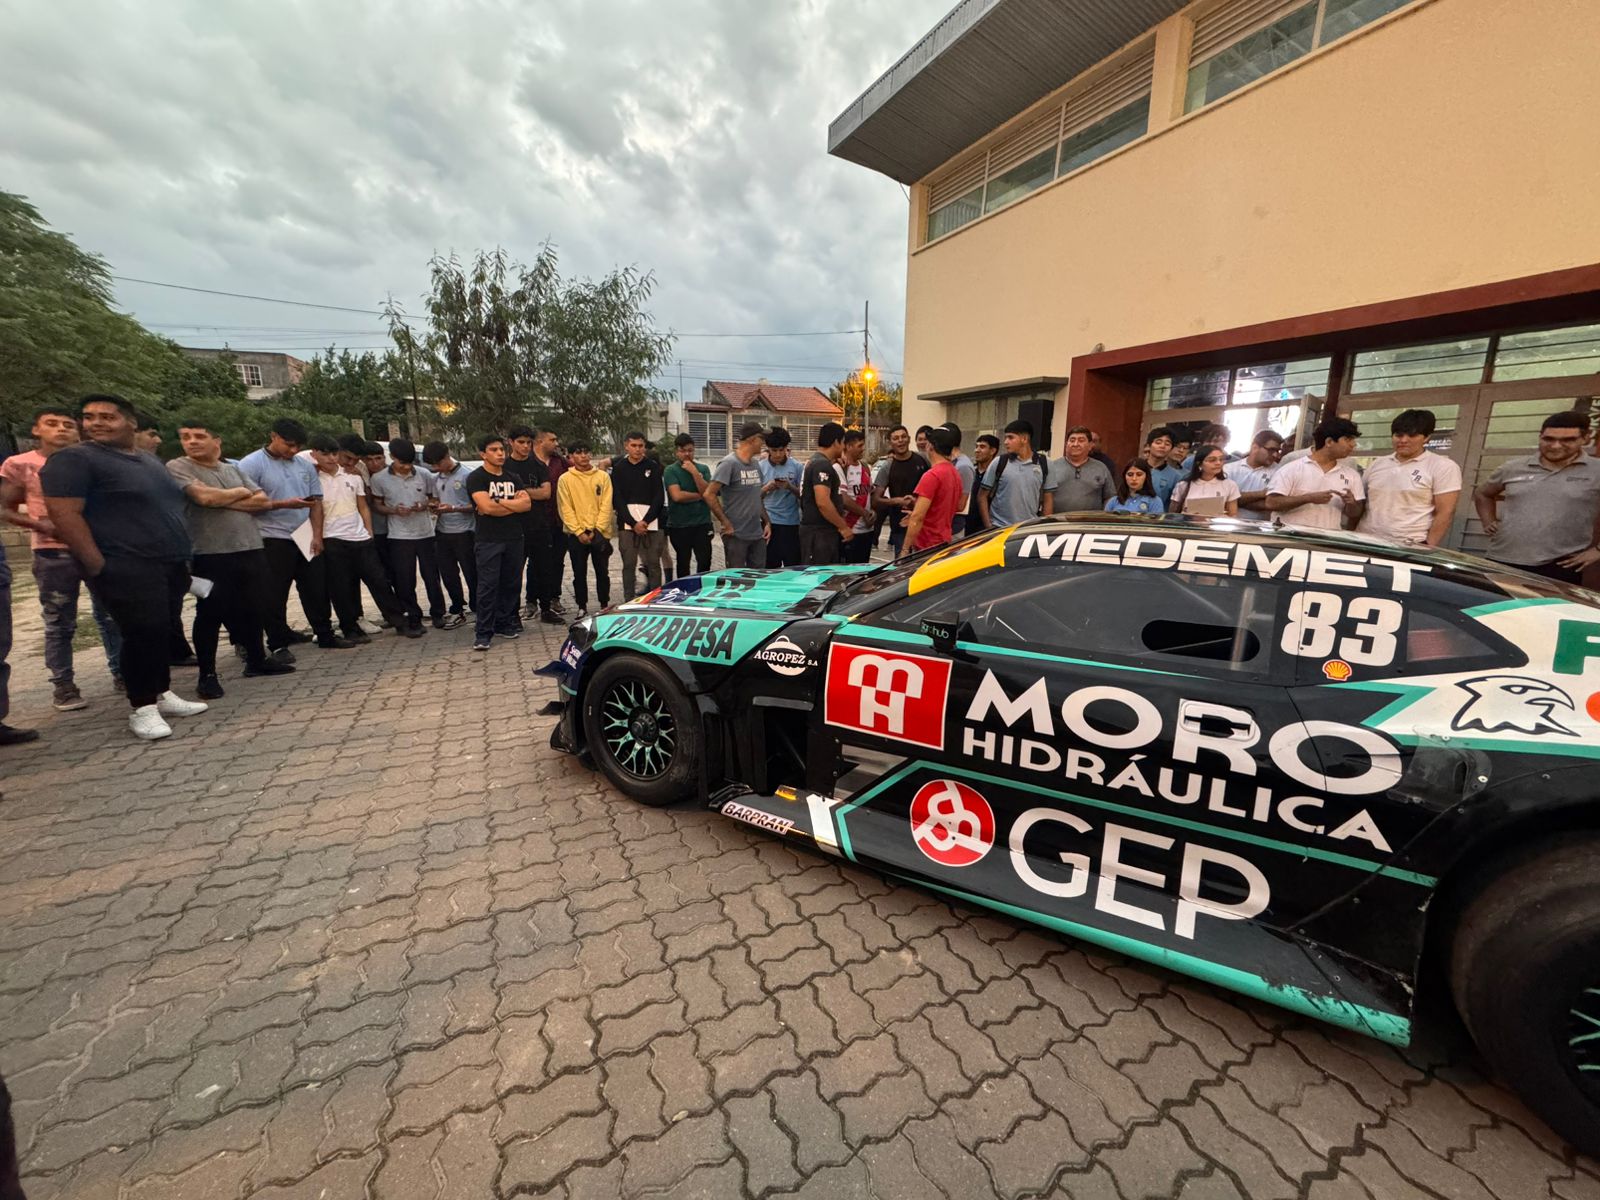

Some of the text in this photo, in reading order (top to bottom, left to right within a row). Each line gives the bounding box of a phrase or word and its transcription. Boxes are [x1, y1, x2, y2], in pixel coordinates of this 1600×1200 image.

[489, 481, 515, 499] ACID
[1018, 533, 1433, 593] MEDEMET
[600, 615, 738, 660] CONARPESA
[753, 650, 806, 665] AGROPEZ
[1280, 591, 1404, 667] 83
[965, 667, 1403, 795] MORO
[962, 726, 1393, 853] HIDRÁULICA
[1008, 807, 1271, 940] GEP
